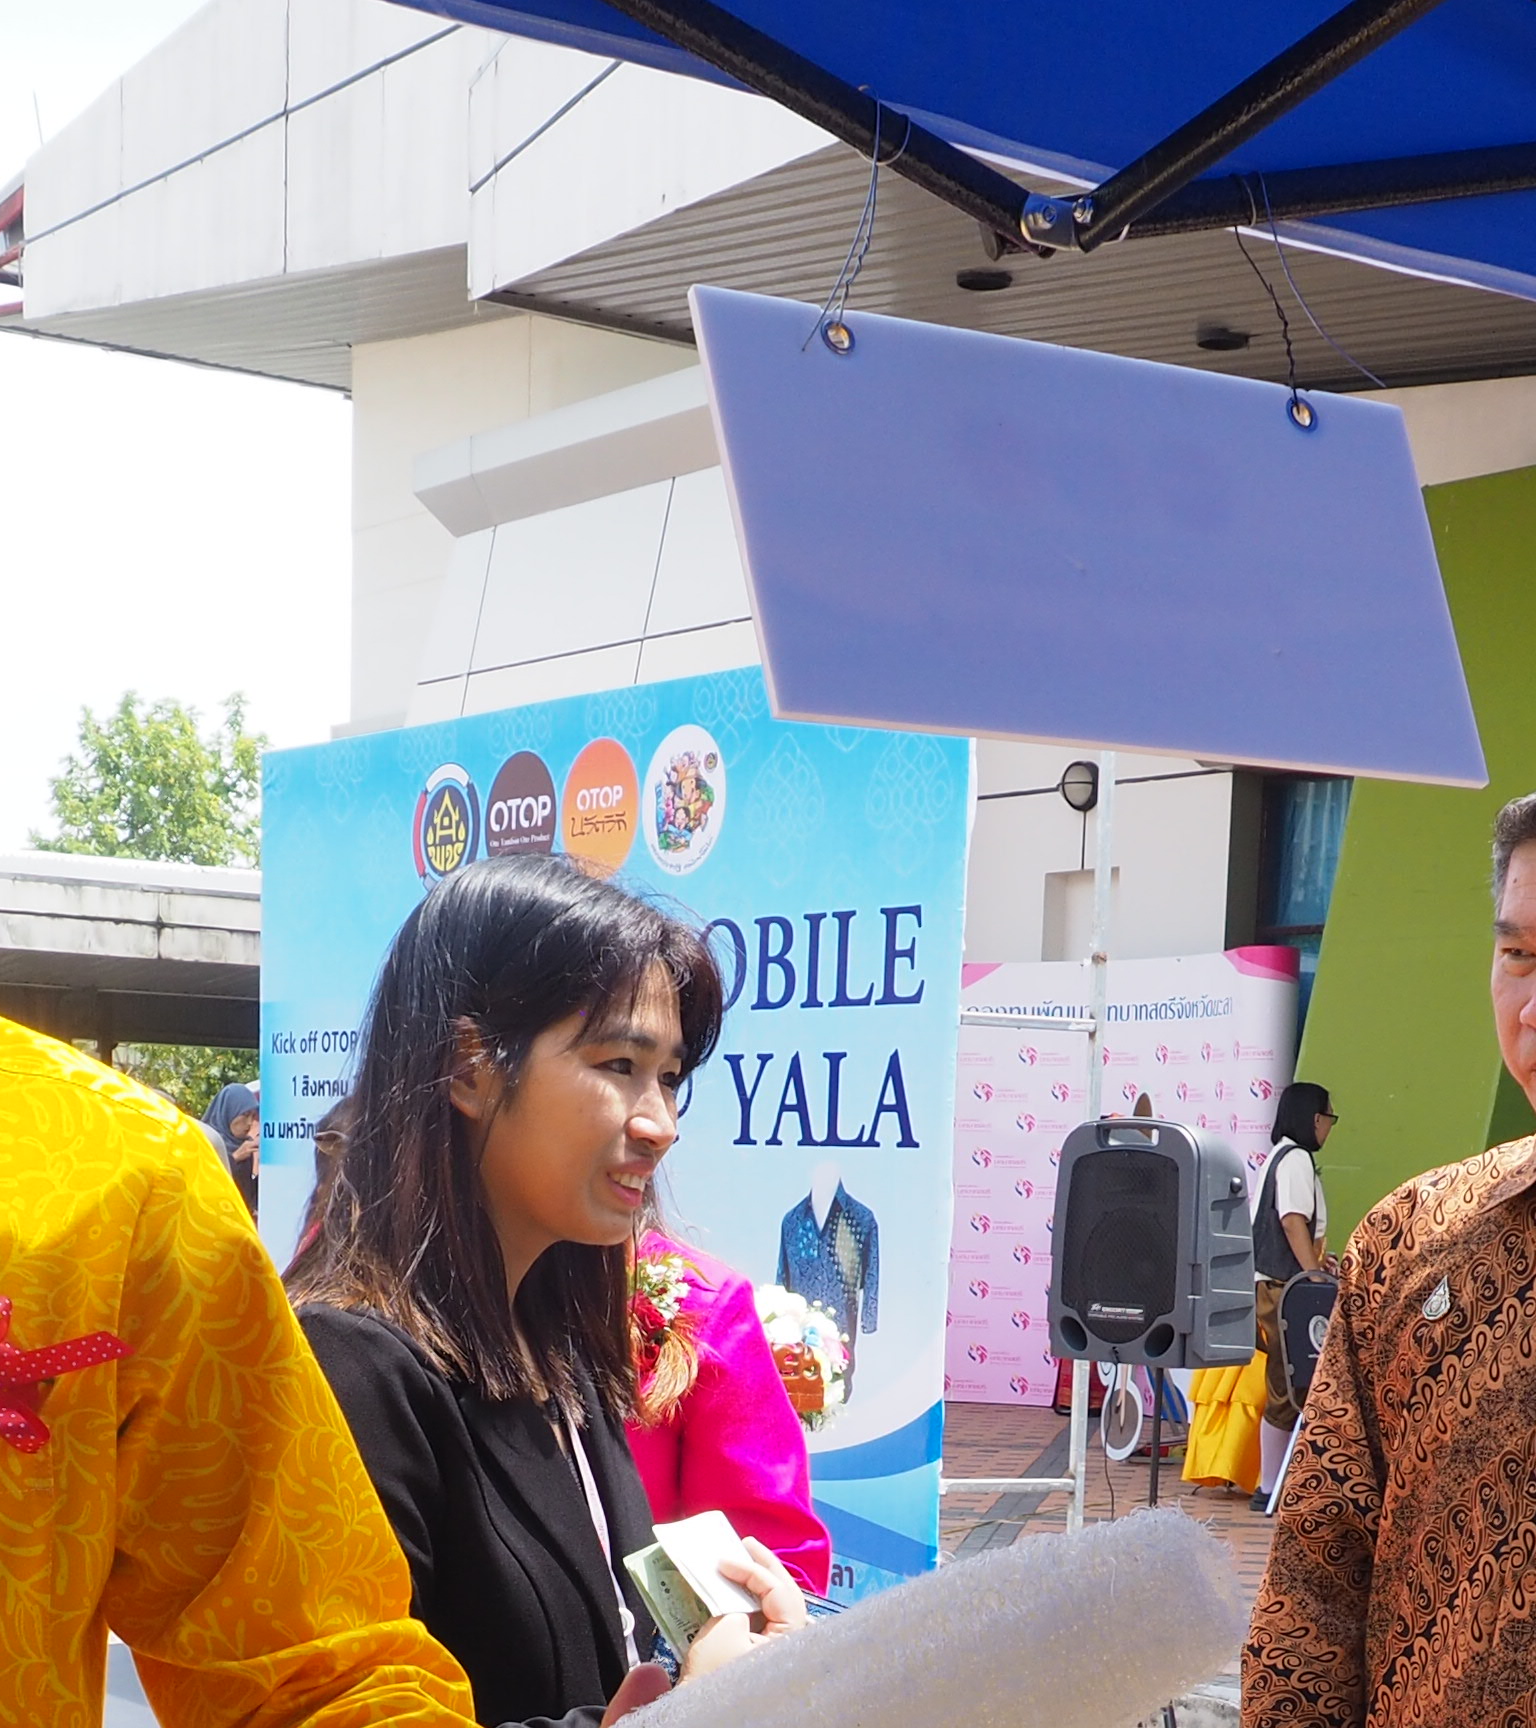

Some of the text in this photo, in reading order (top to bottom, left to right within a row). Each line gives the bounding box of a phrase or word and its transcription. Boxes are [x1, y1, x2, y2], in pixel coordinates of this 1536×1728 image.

[576, 785, 623, 811] OTOP
[490, 795, 552, 832] OTOP
[271, 1030, 358, 1054] Kick off OTOP
[292, 1075, 348, 1096] 1 สิงหาคม
[724, 1049, 919, 1148] YALA
[264, 1118, 316, 1139] ณ มหาวิท
